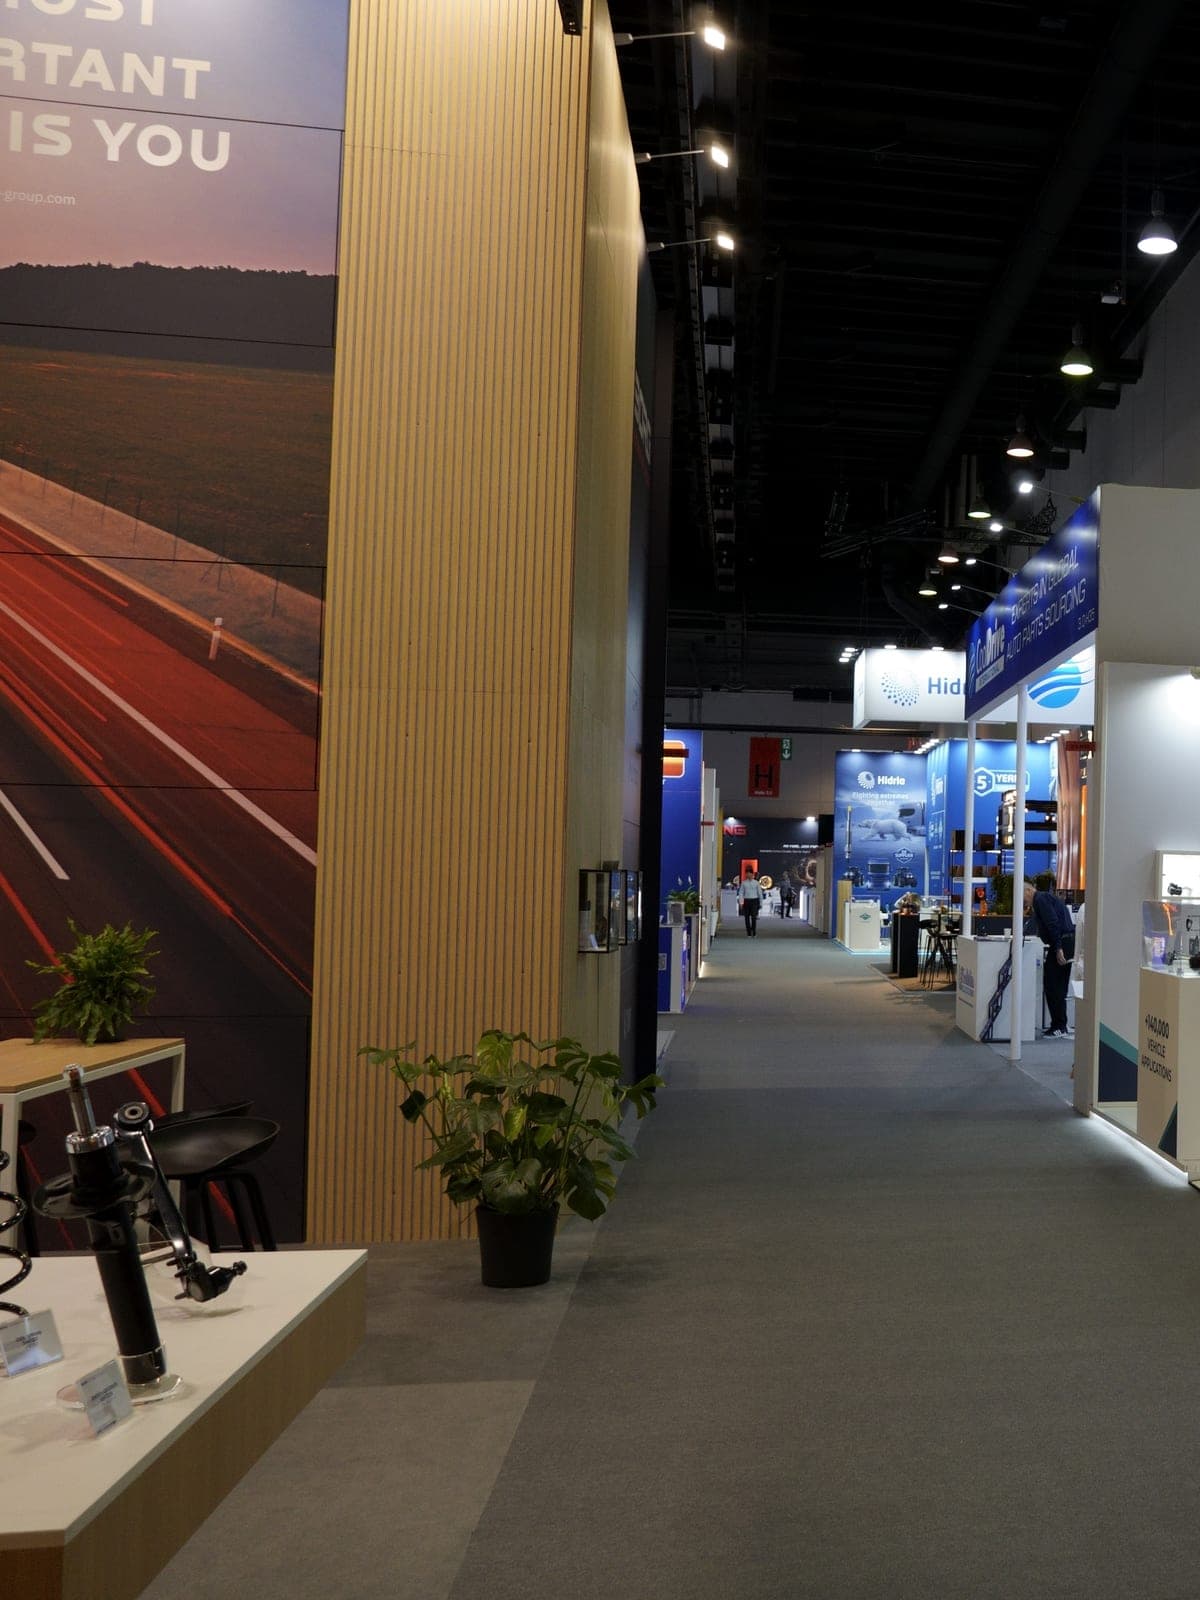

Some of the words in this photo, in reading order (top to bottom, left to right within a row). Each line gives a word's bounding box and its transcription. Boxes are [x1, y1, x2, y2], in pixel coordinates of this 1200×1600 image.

[9, 110, 72, 156] IS
[94, 119, 231, 172] YOU
[1007, 631, 1022, 660] AUTO
[1022, 613, 1044, 646] PARTS
[1044, 578, 1087, 632] SOURCING
[928, 677, 966, 696] Hid
[977, 775, 988, 790] 5
[1147, 1038, 1166, 1058] VEHICLE
[1141, 1055, 1172, 1082] APPLICATIONS
